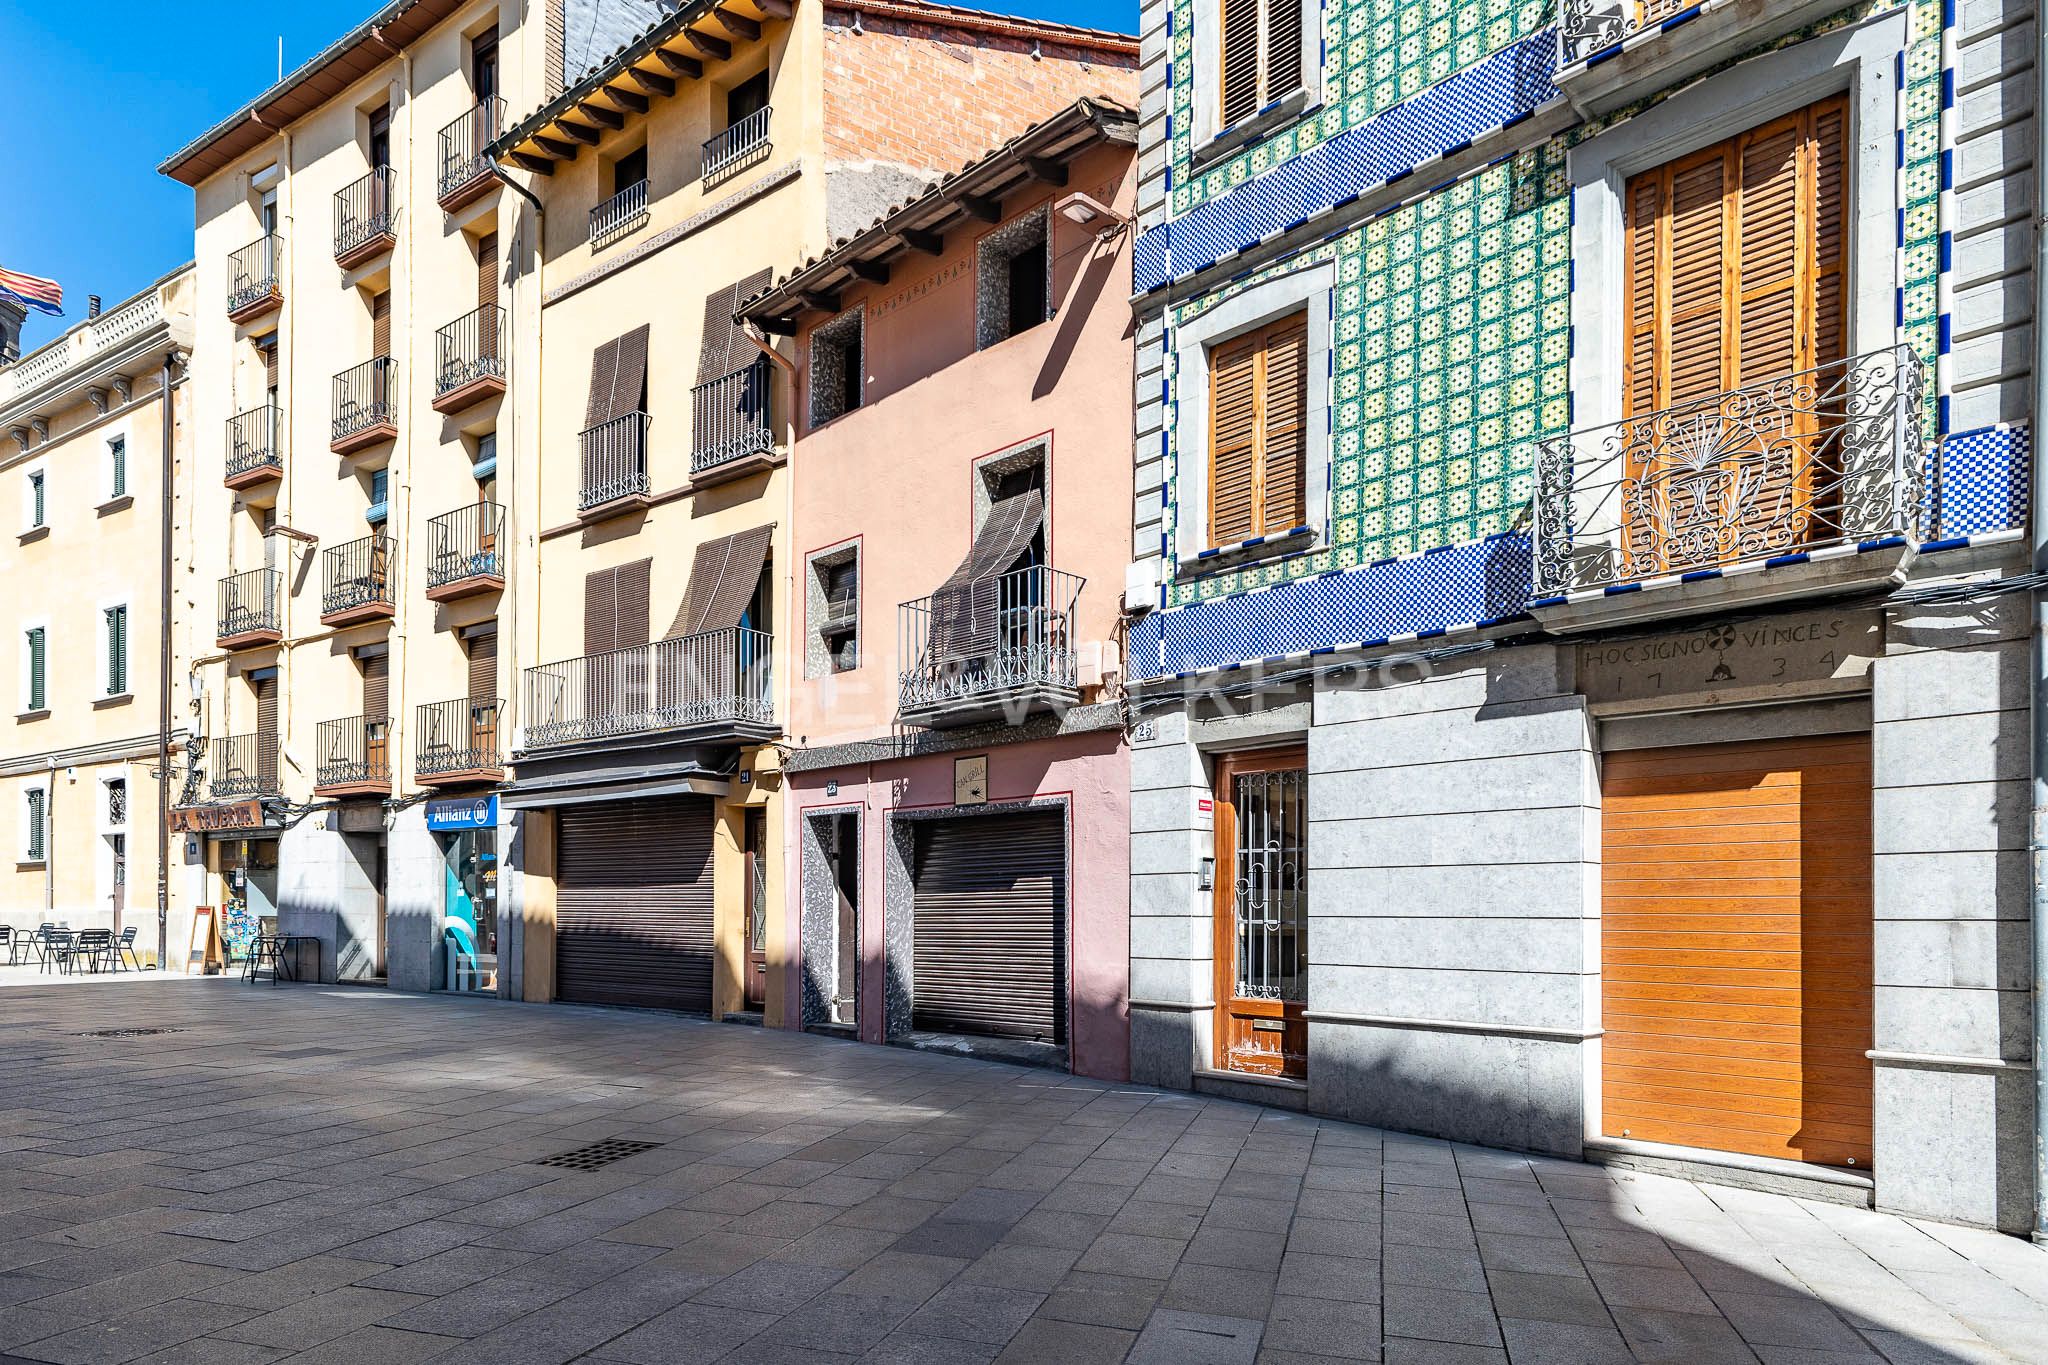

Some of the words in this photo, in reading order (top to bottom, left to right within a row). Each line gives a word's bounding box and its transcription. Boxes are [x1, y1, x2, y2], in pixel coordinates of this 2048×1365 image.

[1584, 648, 1634, 668] HOC
[1640, 637, 1706, 662] SIGNO
[1138, 723, 1153, 737] 25
[173, 811, 191, 831] LA
[433, 805, 472, 823] Allianz
